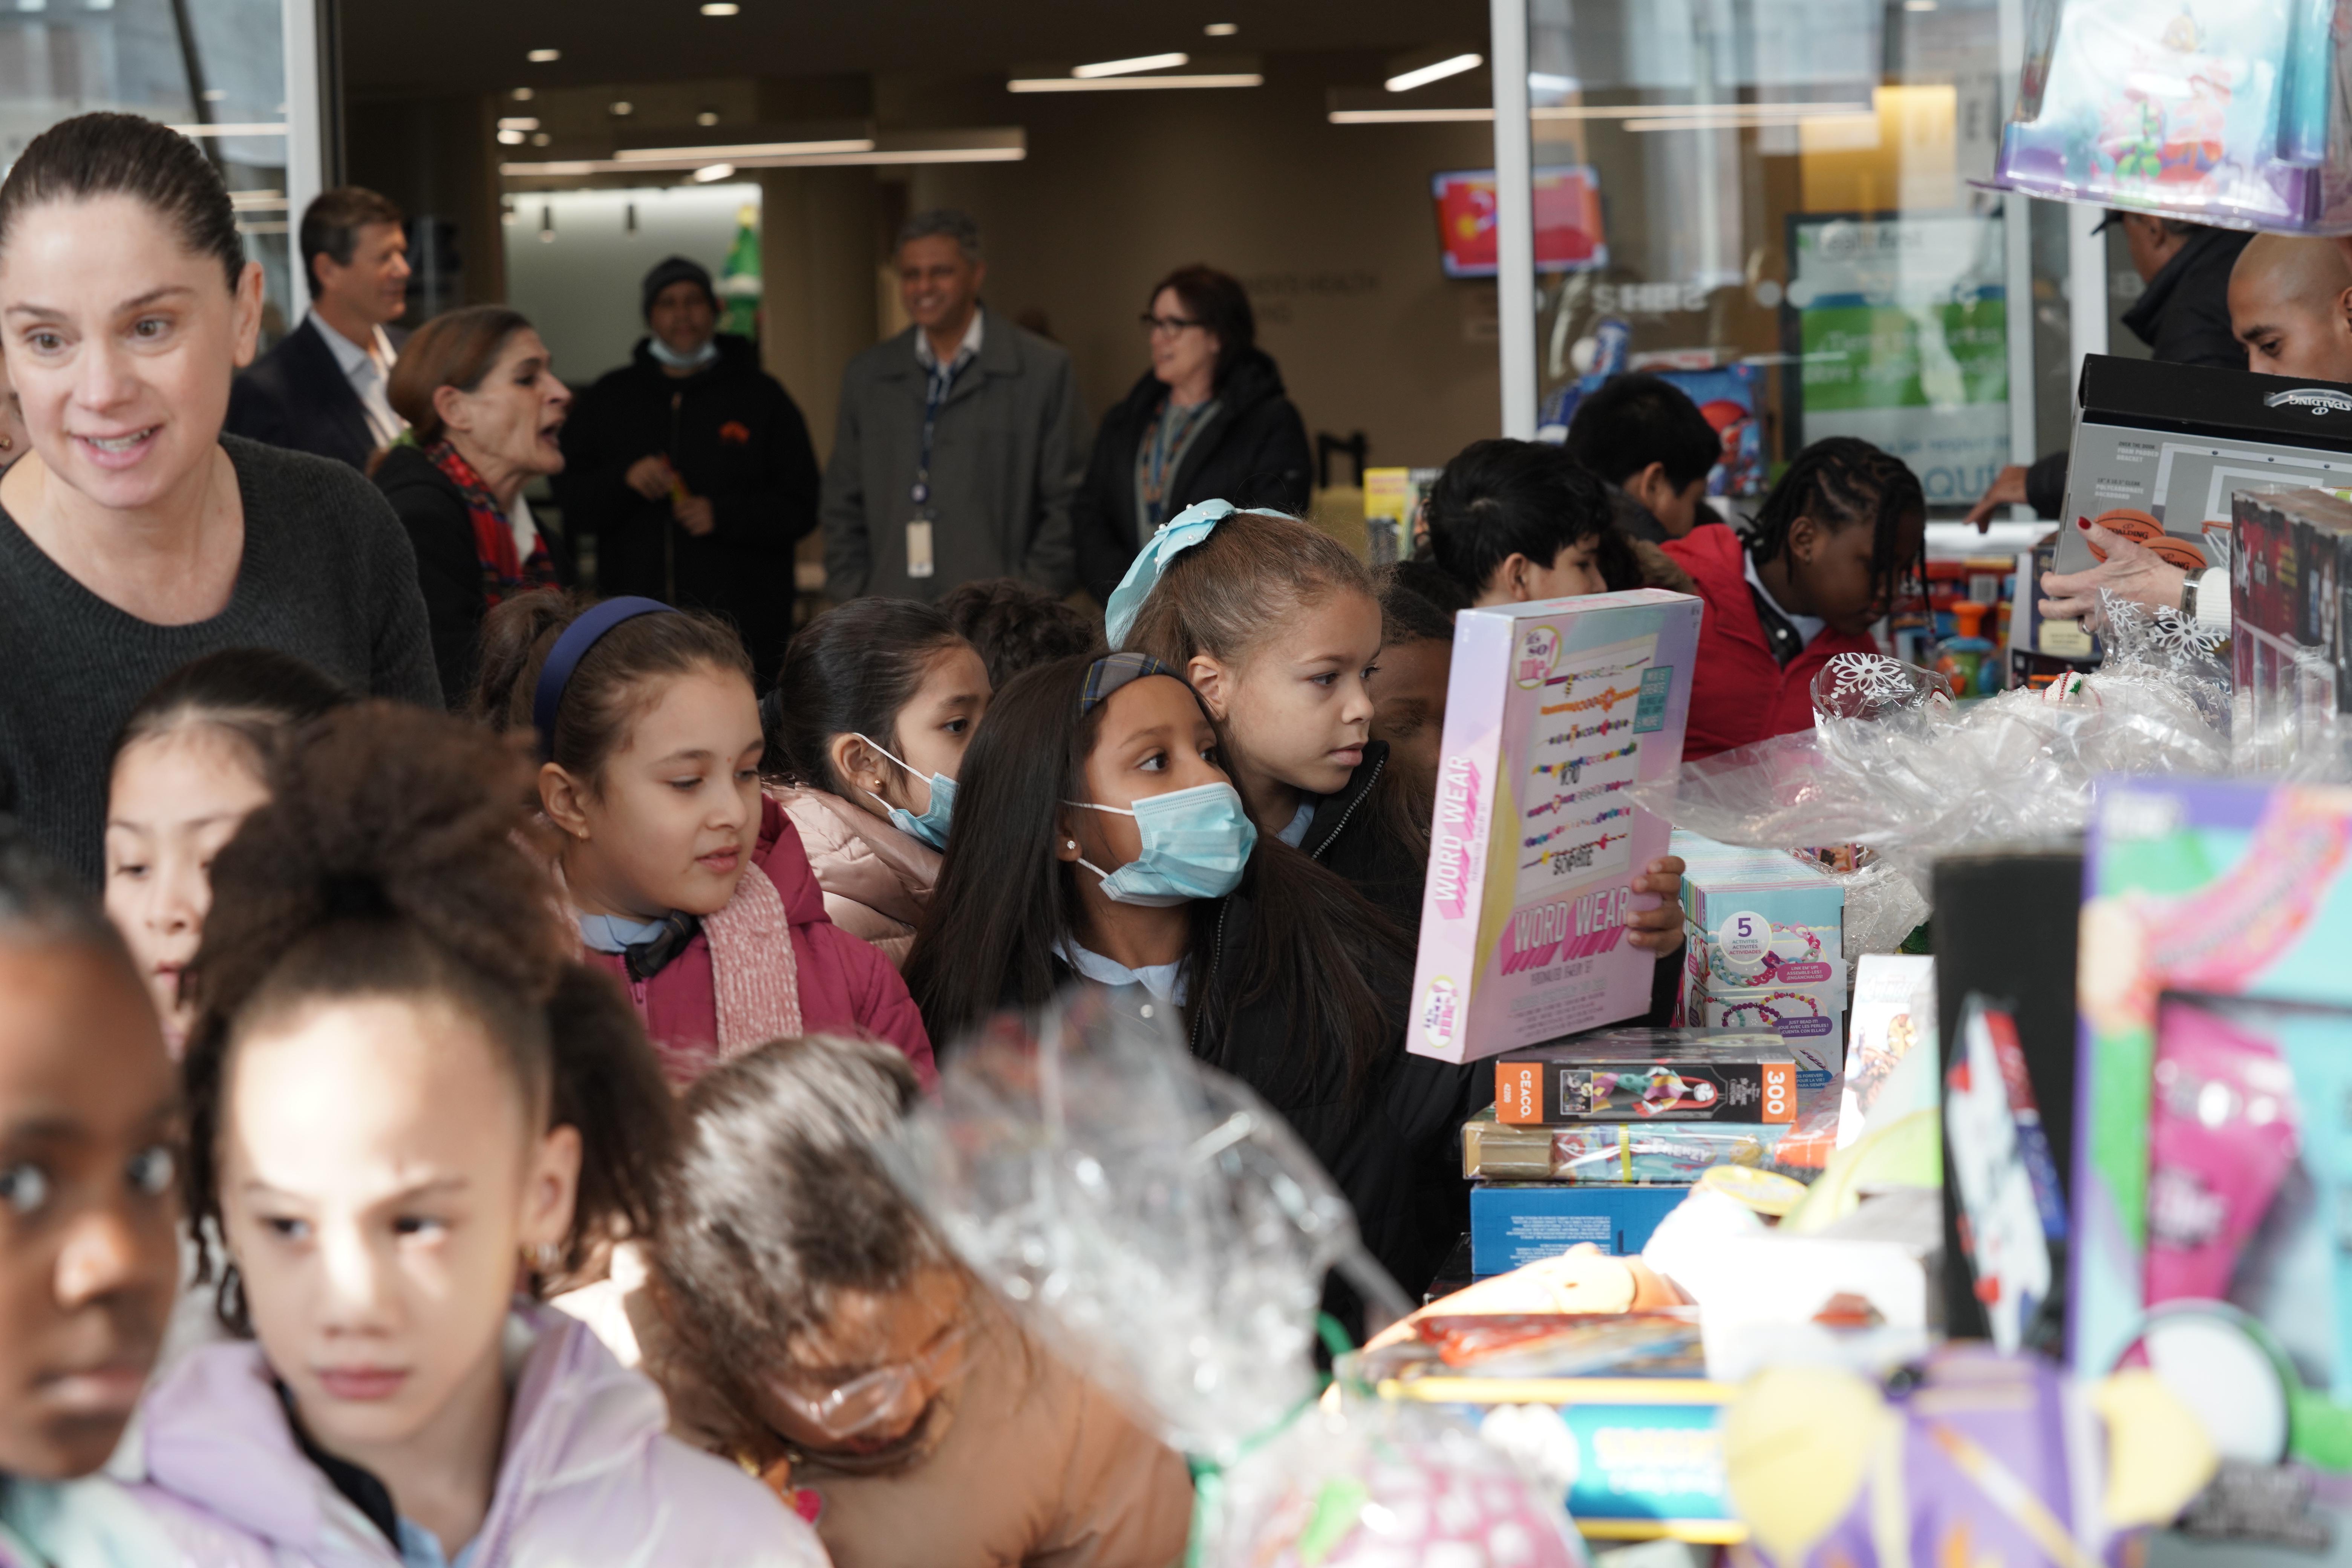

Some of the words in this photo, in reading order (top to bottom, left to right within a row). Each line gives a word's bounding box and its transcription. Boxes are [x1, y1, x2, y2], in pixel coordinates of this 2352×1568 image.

[1442, 755, 1471, 823] WEAR
[1434, 834, 1463, 902] WORD
[1514, 900, 1568, 954] WORD
[1575, 886, 1630, 937] WEAR
[1738, 917, 1752, 937] 5
[1767, 1070, 1785, 1115] 300
